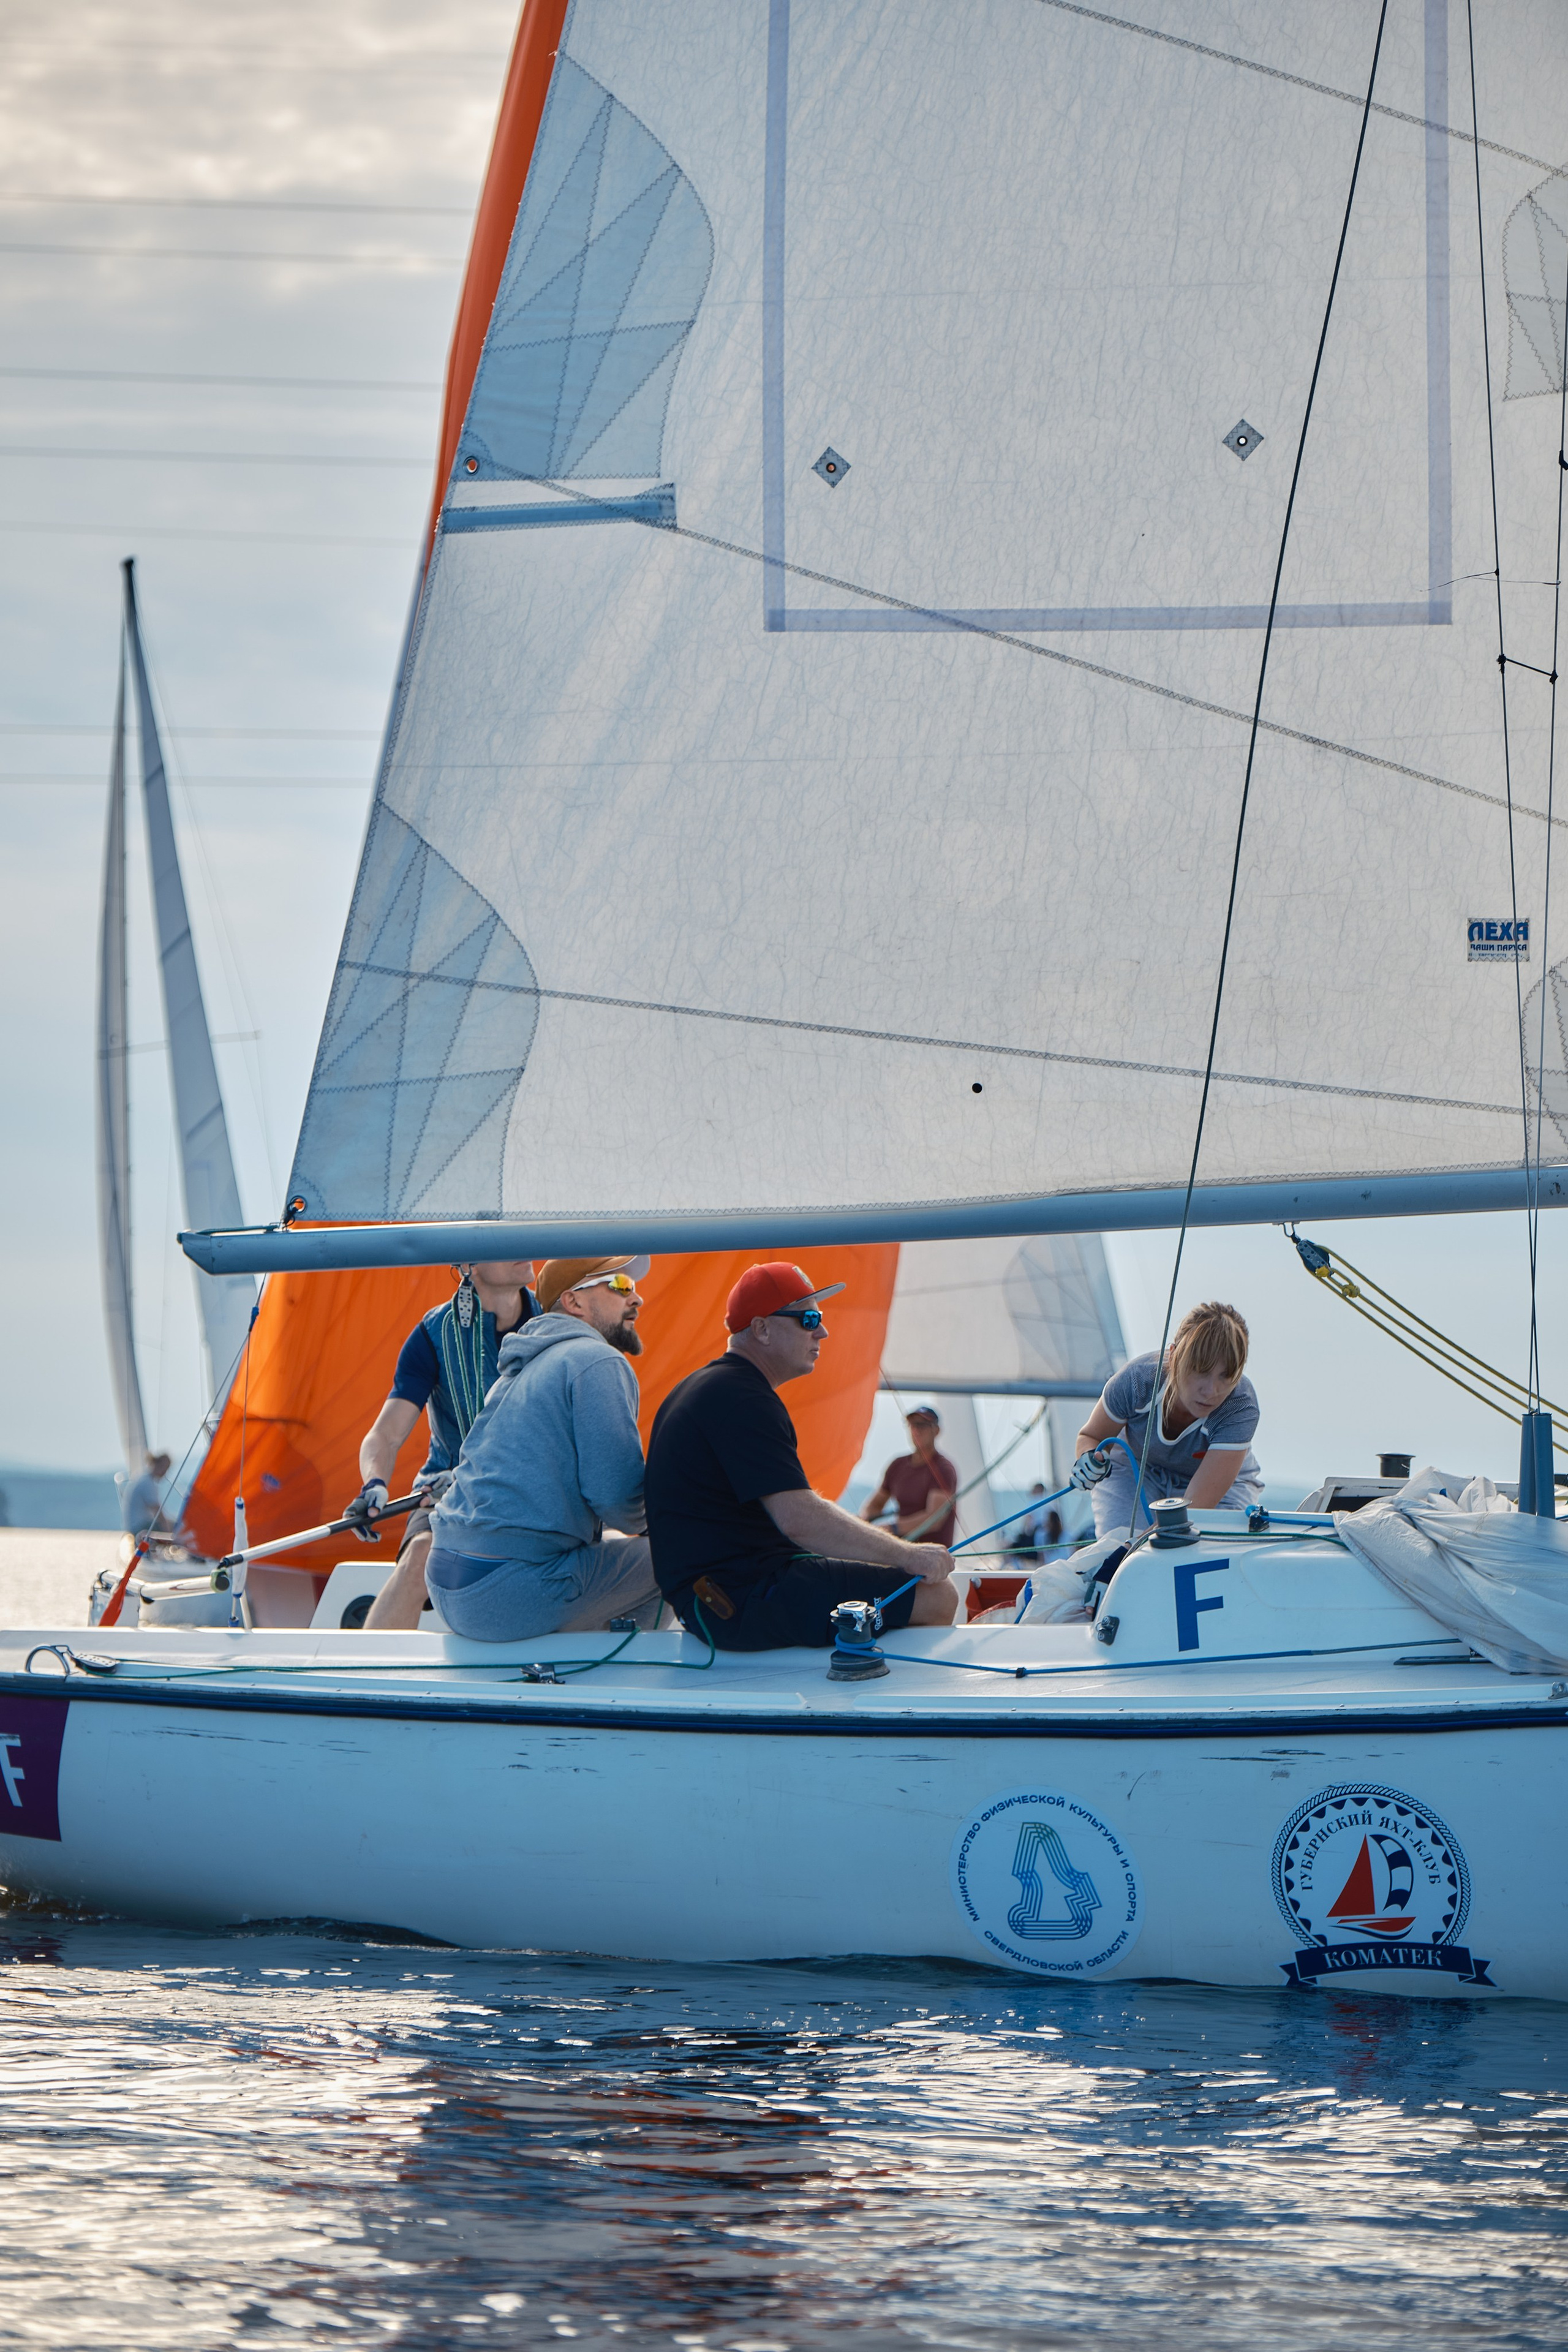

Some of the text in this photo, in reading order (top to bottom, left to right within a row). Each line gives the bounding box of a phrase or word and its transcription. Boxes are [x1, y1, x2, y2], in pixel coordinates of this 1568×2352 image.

[1468, 922, 1528, 942] ЛЕХА
[1174, 1558, 1229, 1652] F
[0, 1733, 25, 1807] F
[957, 1794, 1137, 1923] МИНИСТЕРСТВО ФИЗИЧЕСКОЙ КУЛЬТУРЫ И СПОРТА
[1300, 1810, 1442, 1891] ГУБЕРНСКИЙ ЯХТ-КЛУБ
[984, 1930, 1129, 1972] СВЕРДЛОВСКОЙ ОБЛАСТИ
[1322, 1948, 1443, 1969] КОМАТЕК
